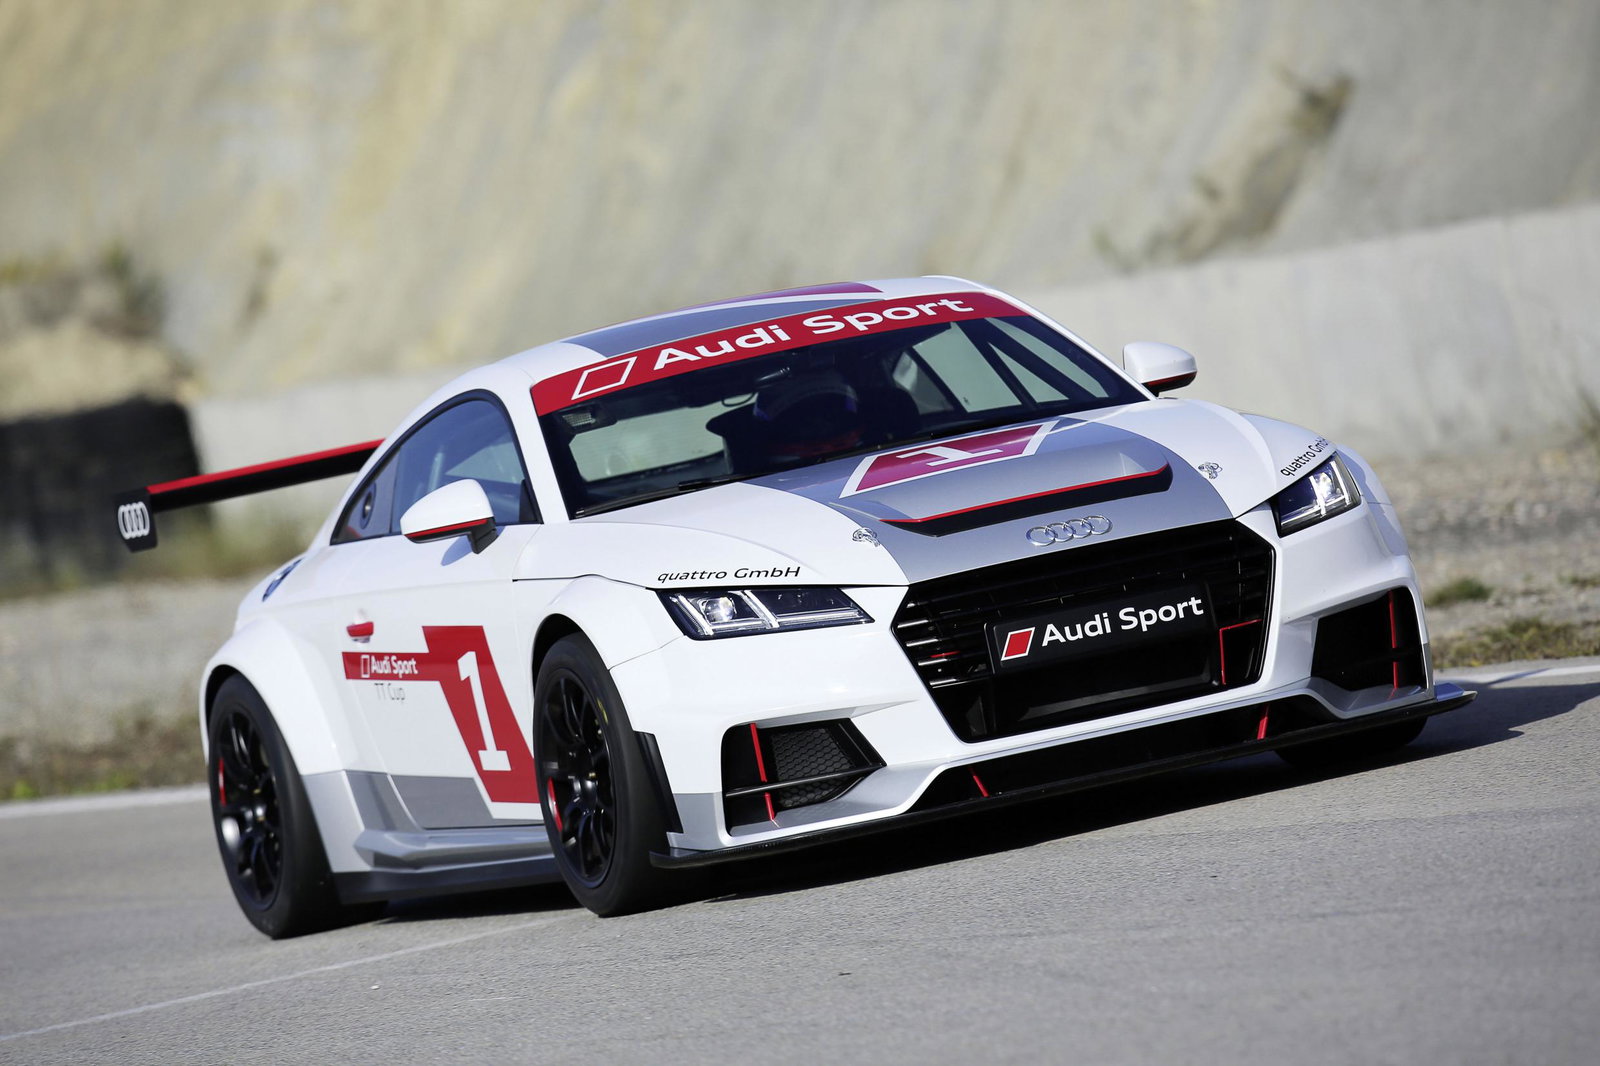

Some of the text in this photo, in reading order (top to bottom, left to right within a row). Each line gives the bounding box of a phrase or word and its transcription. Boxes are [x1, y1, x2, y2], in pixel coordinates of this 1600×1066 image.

[653, 297, 975, 371] Audi Sport
[1280, 451, 1316, 477] quattro
[657, 566, 801, 584] quattro GmbH
[1041, 596, 1204, 647] Audi Sport
[371, 655, 418, 679] Audi Sport
[457, 650, 512, 772] 1
